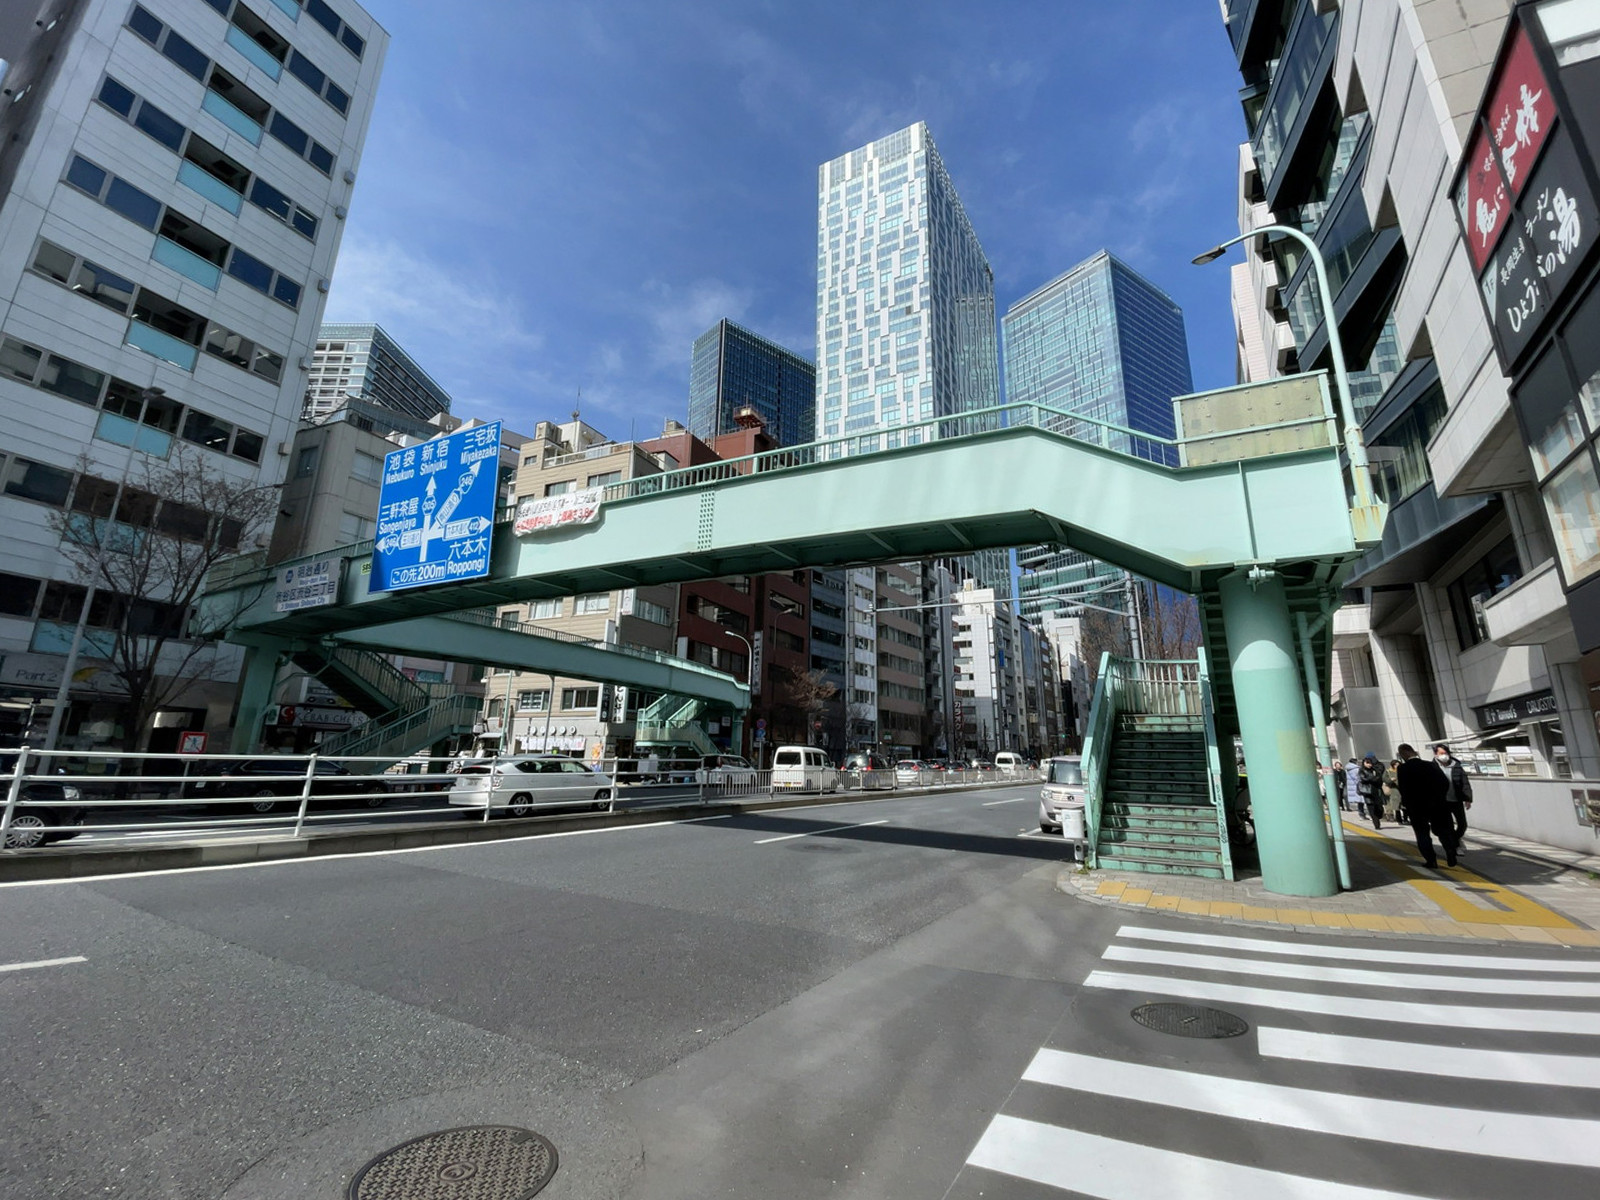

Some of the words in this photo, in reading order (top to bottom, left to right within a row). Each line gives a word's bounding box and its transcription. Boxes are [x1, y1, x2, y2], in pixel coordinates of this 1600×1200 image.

[463, 424, 498, 450] 三宅坂
[389, 449, 416, 471] 池袋
[421, 439, 449, 461] 新宿
[460, 444, 498, 465] Miyakezaka
[385, 469, 415, 485] Ikebukuro
[420, 458, 448, 476] Shinjuku
[380, 497, 419, 521] 三軒茶屋
[379, 517, 417, 535] Sangenjaya
[448, 536, 488, 560] 六本木
[447, 555, 486, 576] Roppongi
[16, 669, 46, 681] Part
[48, 673, 57, 682] 2
